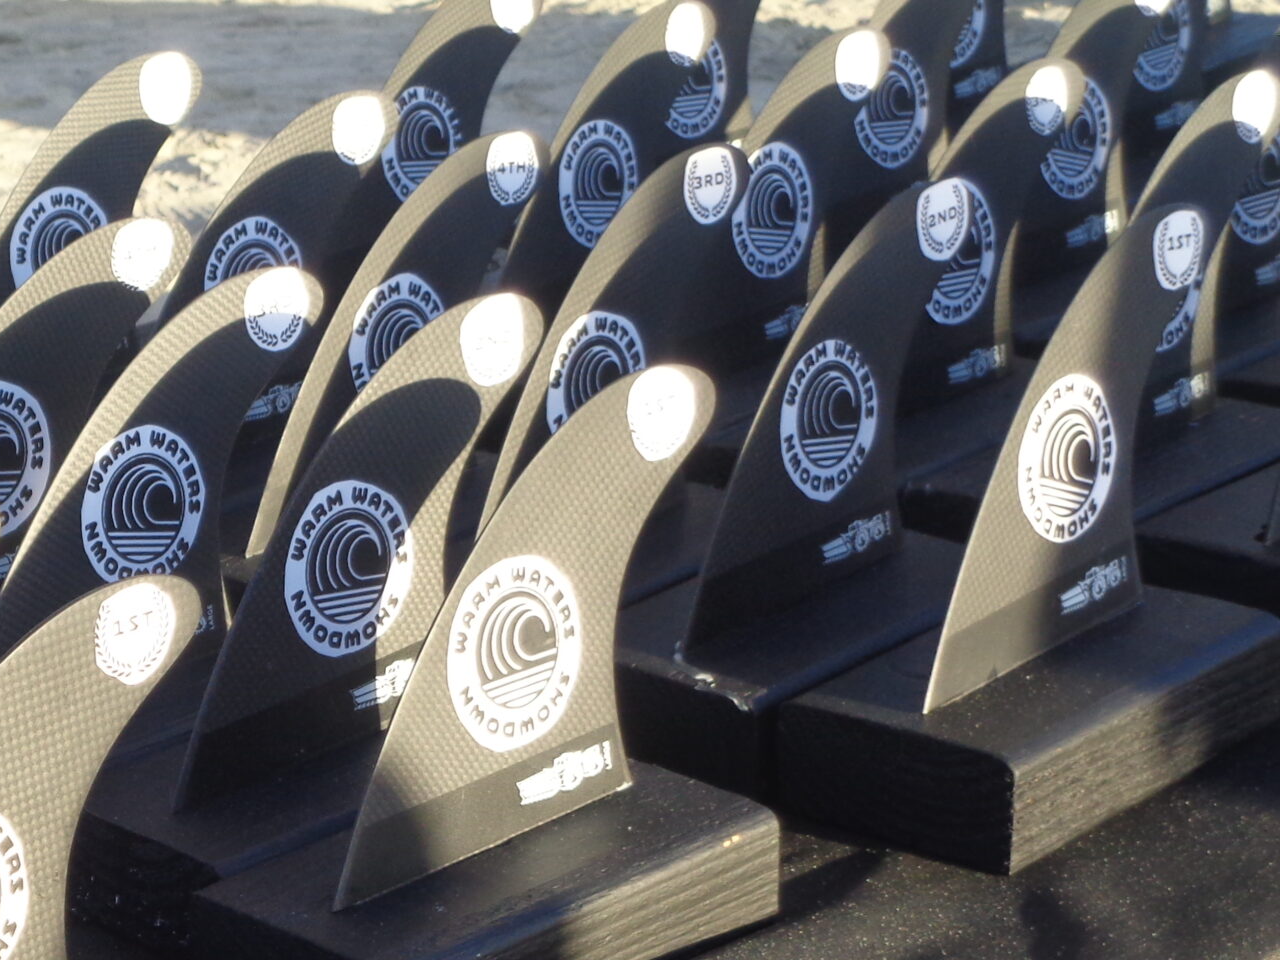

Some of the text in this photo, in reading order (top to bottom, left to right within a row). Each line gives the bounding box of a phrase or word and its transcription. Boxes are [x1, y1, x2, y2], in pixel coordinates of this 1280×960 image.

[497, 162, 526, 174] 4TH
[564, 123, 597, 171] WARM
[694, 172, 724, 190] 3RD
[16, 192, 101, 264] WARM WATER
[927, 206, 957, 228] 2ND
[1167, 233, 1192, 251] 1ST
[207, 223, 248, 282] WARM
[356, 281, 401, 336] WARM
[595, 316, 641, 369] WATER
[784, 339, 875, 419] WARM WATERS
[88, 430, 200, 515] WARM WATERS
[783, 433, 866, 493] SHOWDOWN
[290, 486, 408, 564] WARM WATERS
[113, 610, 153, 636] 1ST
[290, 589, 399, 648] SHOWDOWN
[455, 566, 576, 654] WARM WATERS
[460, 672, 570, 738] SHOWDOWN
